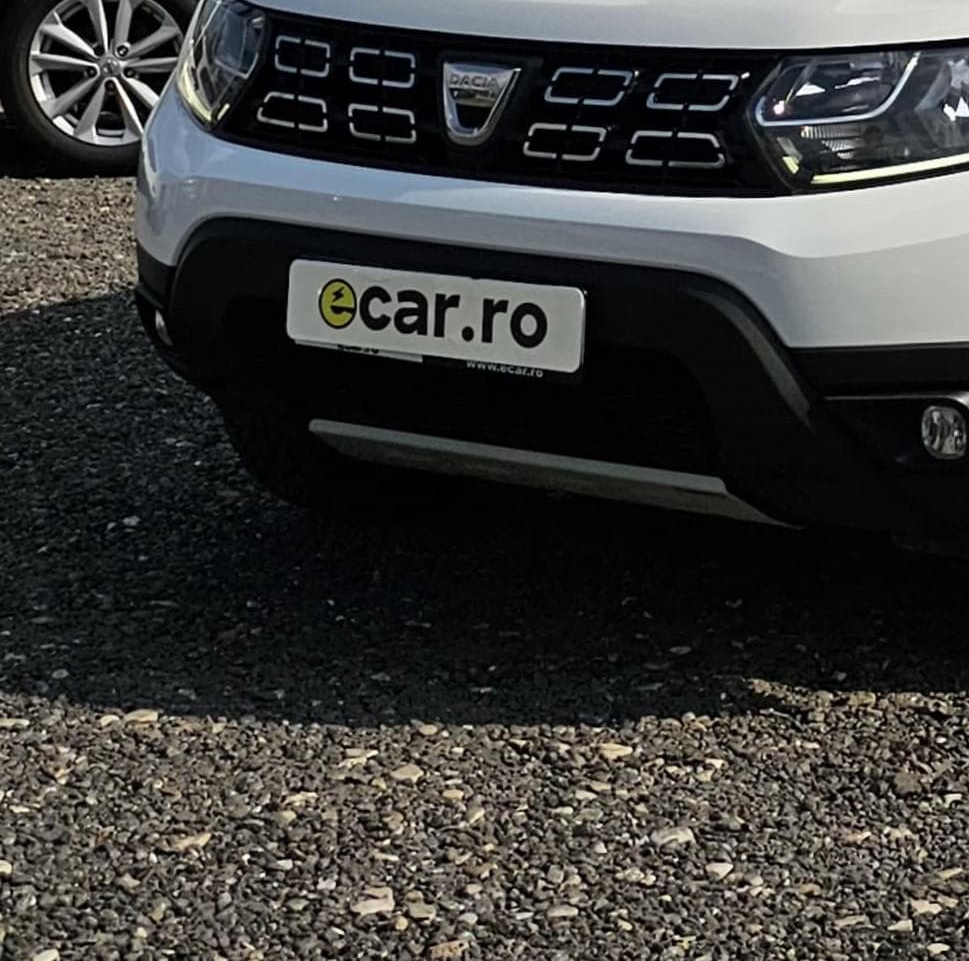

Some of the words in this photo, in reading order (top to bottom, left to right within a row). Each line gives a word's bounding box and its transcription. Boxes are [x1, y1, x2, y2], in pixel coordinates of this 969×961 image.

[449, 73, 500, 93] DACIA
[318, 278, 548, 349] ecar.ro
[466, 360, 544, 378] www.ecar.ro
